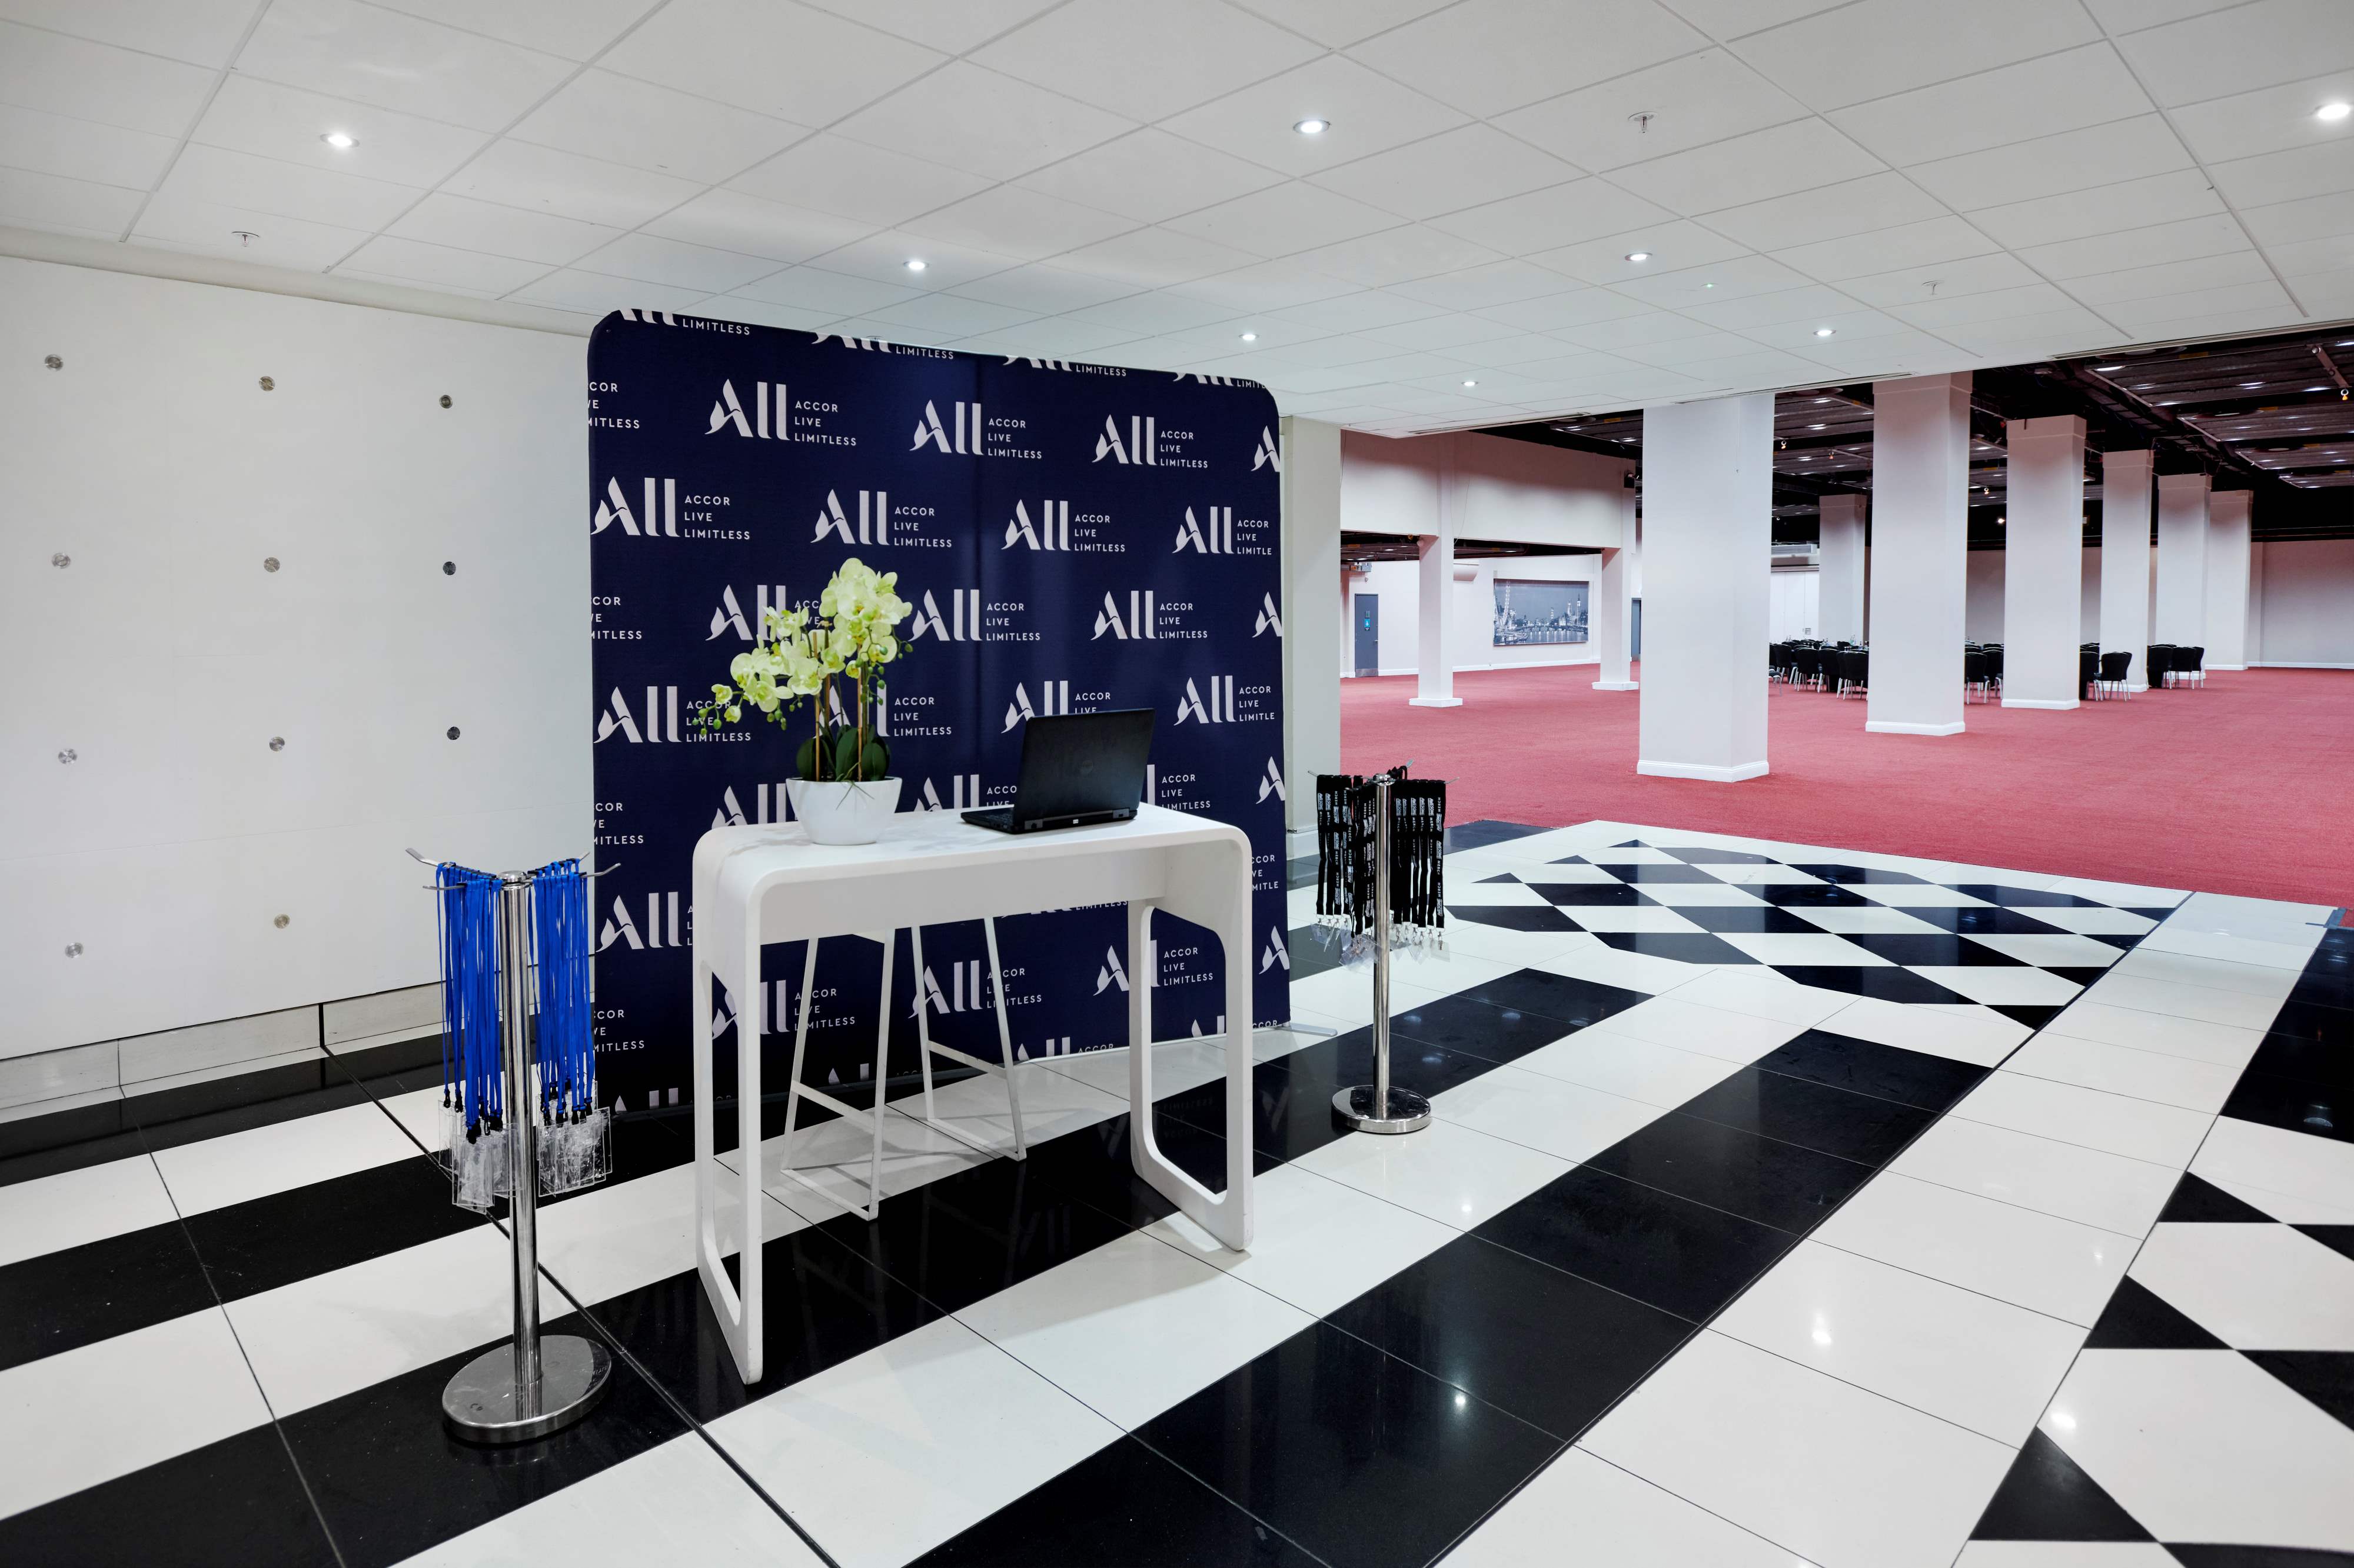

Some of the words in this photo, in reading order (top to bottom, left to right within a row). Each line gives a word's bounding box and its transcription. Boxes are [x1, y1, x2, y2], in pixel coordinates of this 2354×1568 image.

[683, 318, 750, 335] LIMITLESS
[896, 346, 954, 359] LIMITLESS
[1076, 364, 1126, 377] LIMITLESS
[589, 381, 618, 392] COR
[705, 379, 790, 440] All
[796, 401, 837, 412] ACCOR
[588, 417, 640, 429] MITLESS
[795, 417, 820, 427] LIVE
[910, 400, 983, 455] All
[989, 418, 1025, 428] ACCOR
[795, 433, 856, 445] LIMITLESS
[989, 433, 1010, 442] LIVE
[1092, 415, 1156, 465] All
[1161, 431, 1193, 440] ACCOR
[988, 448, 1042, 459] LIMITLESS
[1161, 444, 1181, 452] LIVE
[1161, 458, 1208, 468] LIMITLESS
[685, 495, 730, 505] ACCOR
[591, 476, 680, 537] All
[895, 507, 934, 516] ACCOR
[684, 512, 712, 521] LIVE
[811, 490, 889, 545] All
[895, 522, 918, 531] LIVE
[1002, 500, 1070, 551] All
[1172, 506, 1233, 554] All
[685, 529, 750, 540] LIMITLESS
[895, 538, 952, 547] LIMITLESS
[1075, 544, 1125, 552] LIMITLESS
[593, 597, 621, 605] COR
[794, 600, 819, 608] ACC
[908, 589, 983, 641] All
[1091, 591, 1156, 640] All
[591, 631, 642, 640] MITLESS
[1239, 686, 1271, 694] ACCOR
[895, 697, 934, 705] ACCOR
[1174, 675, 1236, 725] All
[593, 686, 681, 743] All
[895, 713, 918, 721] LIVE
[895, 727, 951, 736] LIMITLESS
[686, 733, 751, 742] LIMITLESS
[1162, 774, 1195, 783] ACCOR
[987, 785, 1017, 795] ACCO
[1162, 789, 1182, 797] LIVE
[595, 803, 623, 811] COR
[594, 835, 644, 845] MITLESS
[596, 892, 682, 952] All
[1164, 947, 1198, 958] ACCOR
[1164, 963, 1184, 972] LIVE
[987, 968, 1025, 980] ACOR
[1164, 973, 1213, 986] LIMITLESS
[794, 988, 837, 1000] ACOR
[987, 995, 1042, 1008] LIITLESS
[594, 1009, 624, 1019] COR
[794, 1017, 855, 1031] LMITLESS
[594, 1040, 645, 1052] MITLESS
